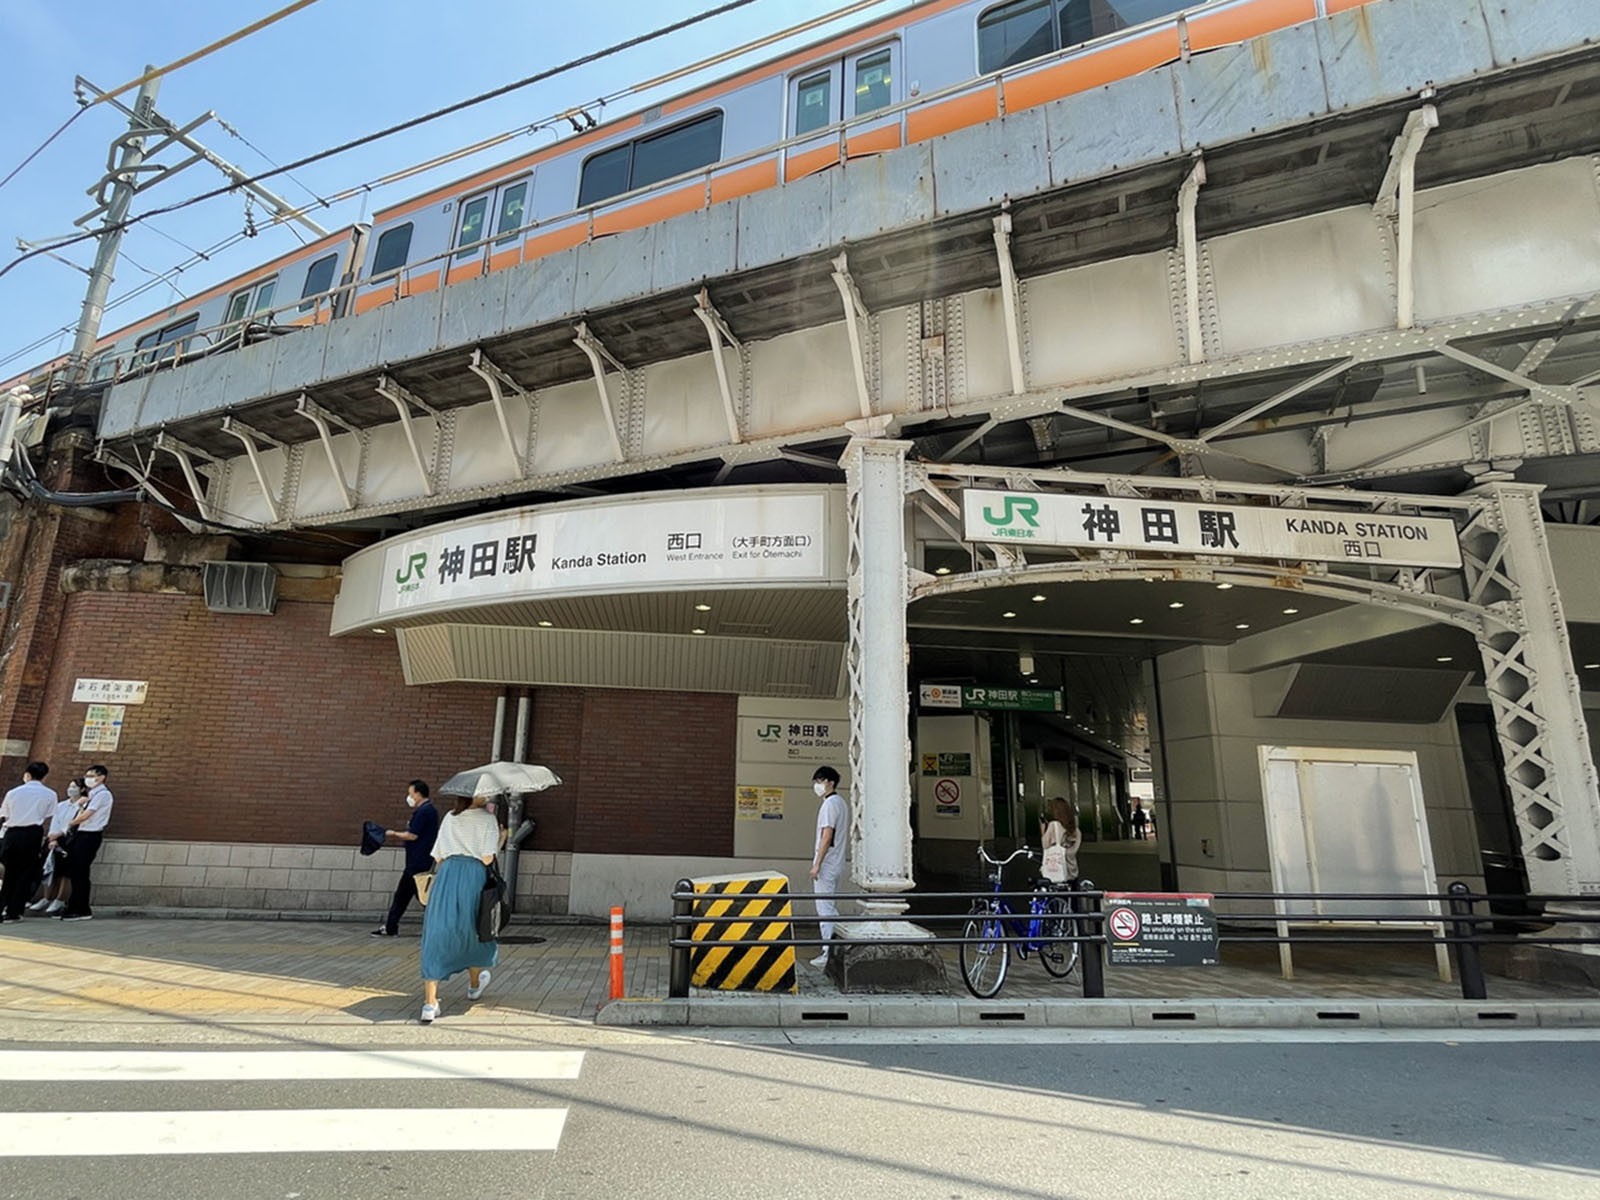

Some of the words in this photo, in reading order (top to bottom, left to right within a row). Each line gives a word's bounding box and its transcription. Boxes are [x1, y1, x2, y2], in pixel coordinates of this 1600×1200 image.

[983, 496, 1040, 527] JR
[992, 527, 1035, 538] JR東日本
[1081, 503, 1240, 549] 神田駅
[1286, 518, 1348, 536] KANDA
[1356, 522, 1428, 540] STATION
[667, 533, 702, 551] 西口
[1343, 540, 1382, 558] 西口
[438, 534, 538, 585] 神田駅
[551, 554, 593, 570] Kanda
[597, 551, 647, 566] Station
[666, 553, 686, 562] West
[688, 552, 724, 561] Entrance
[732, 551, 748, 559] Exit
[749, 550, 760, 559] for
[396, 552, 427, 584] JR
[965, 688, 986, 701] JR
[988, 689, 1019, 701] 神田駅
[757, 724, 782, 738] JR
[788, 724, 829, 738] 神田駅
[788, 738, 813, 746] Kanda
[815, 739, 843, 748] Station
[1141, 913, 1205, 925] 路上喫煙禁止
[1151, 926, 1176, 934] smoking
